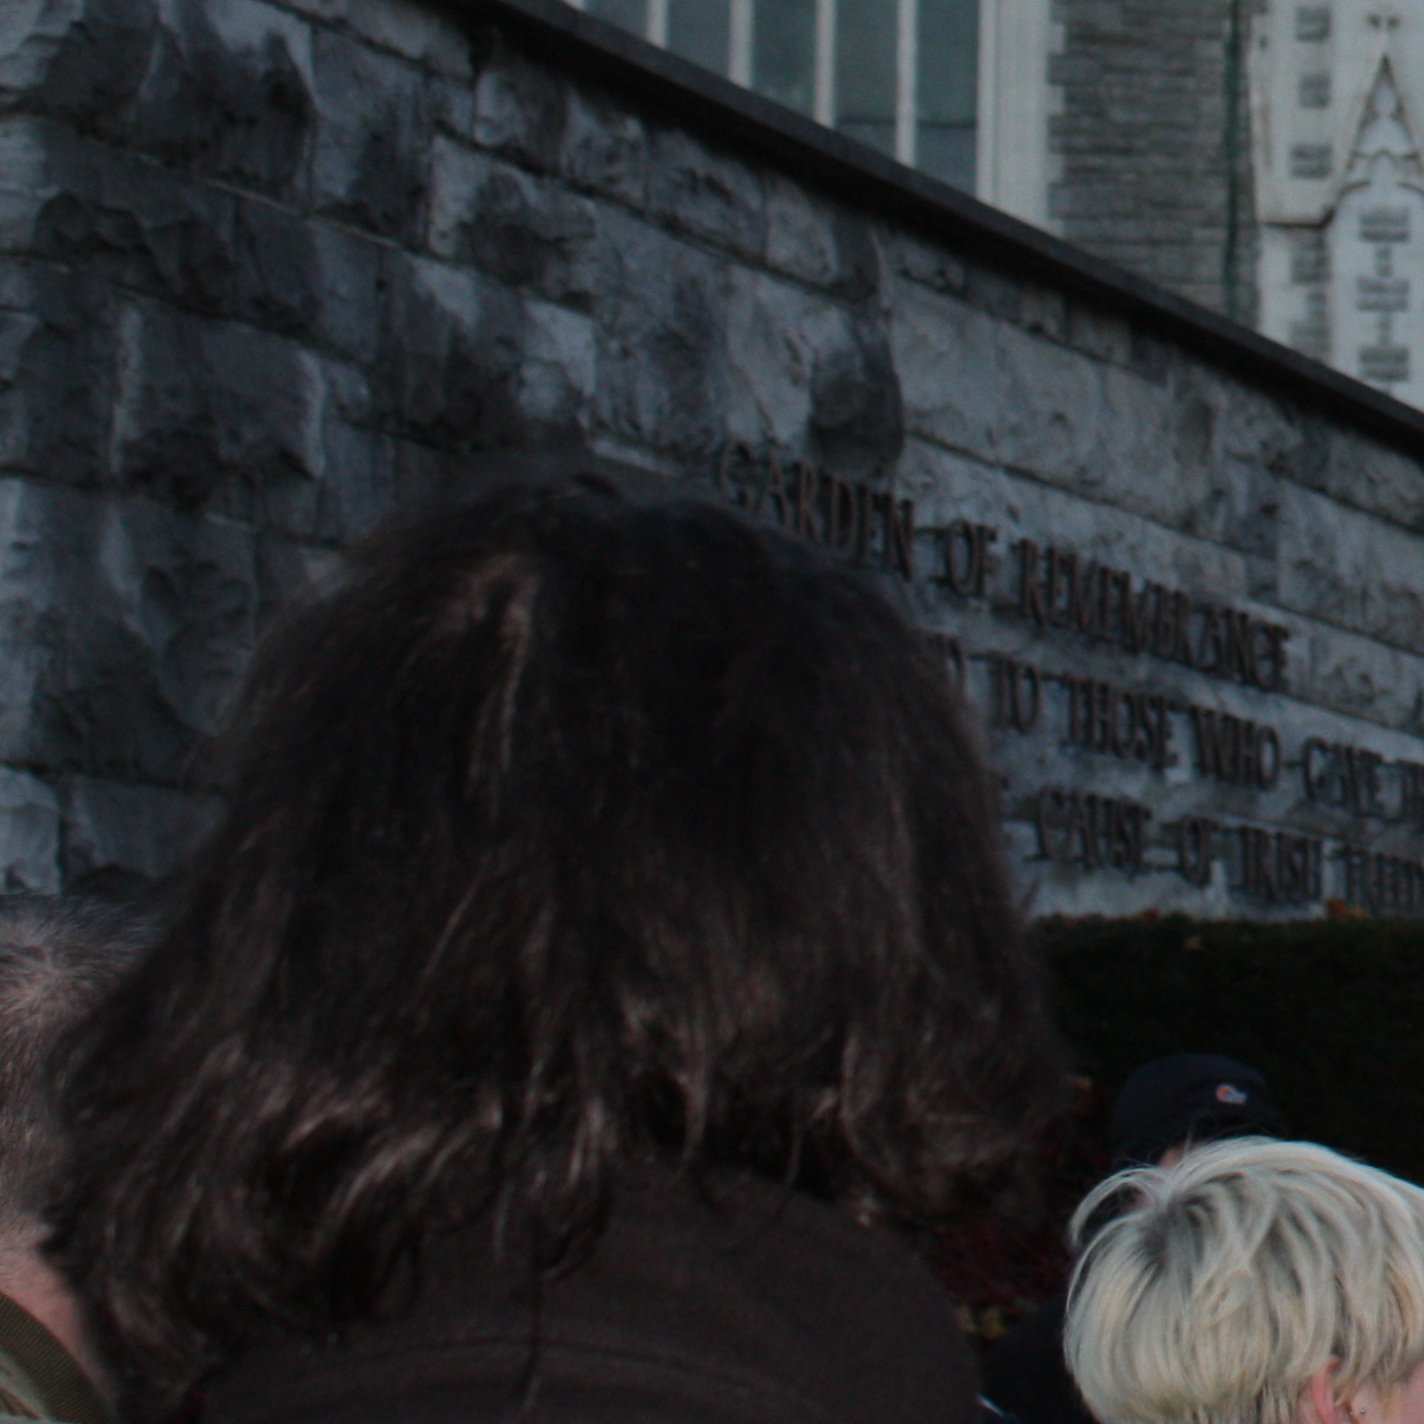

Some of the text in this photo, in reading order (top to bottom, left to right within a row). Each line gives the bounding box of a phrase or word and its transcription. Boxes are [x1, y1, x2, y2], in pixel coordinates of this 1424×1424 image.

[718, 439, 915, 580] GARDEN
[944, 520, 996, 598] OF
[1015, 540, 1289, 689] REMEMBRANCE
[987, 652, 1040, 735] TO
[1060, 672, 1178, 770] THOSE
[1189, 706, 1281, 790] WHO
[1303, 737, 1385, 818] GAVE
[1036, 786, 1151, 880] CAUSE
[1179, 814, 1217, 888] OF
